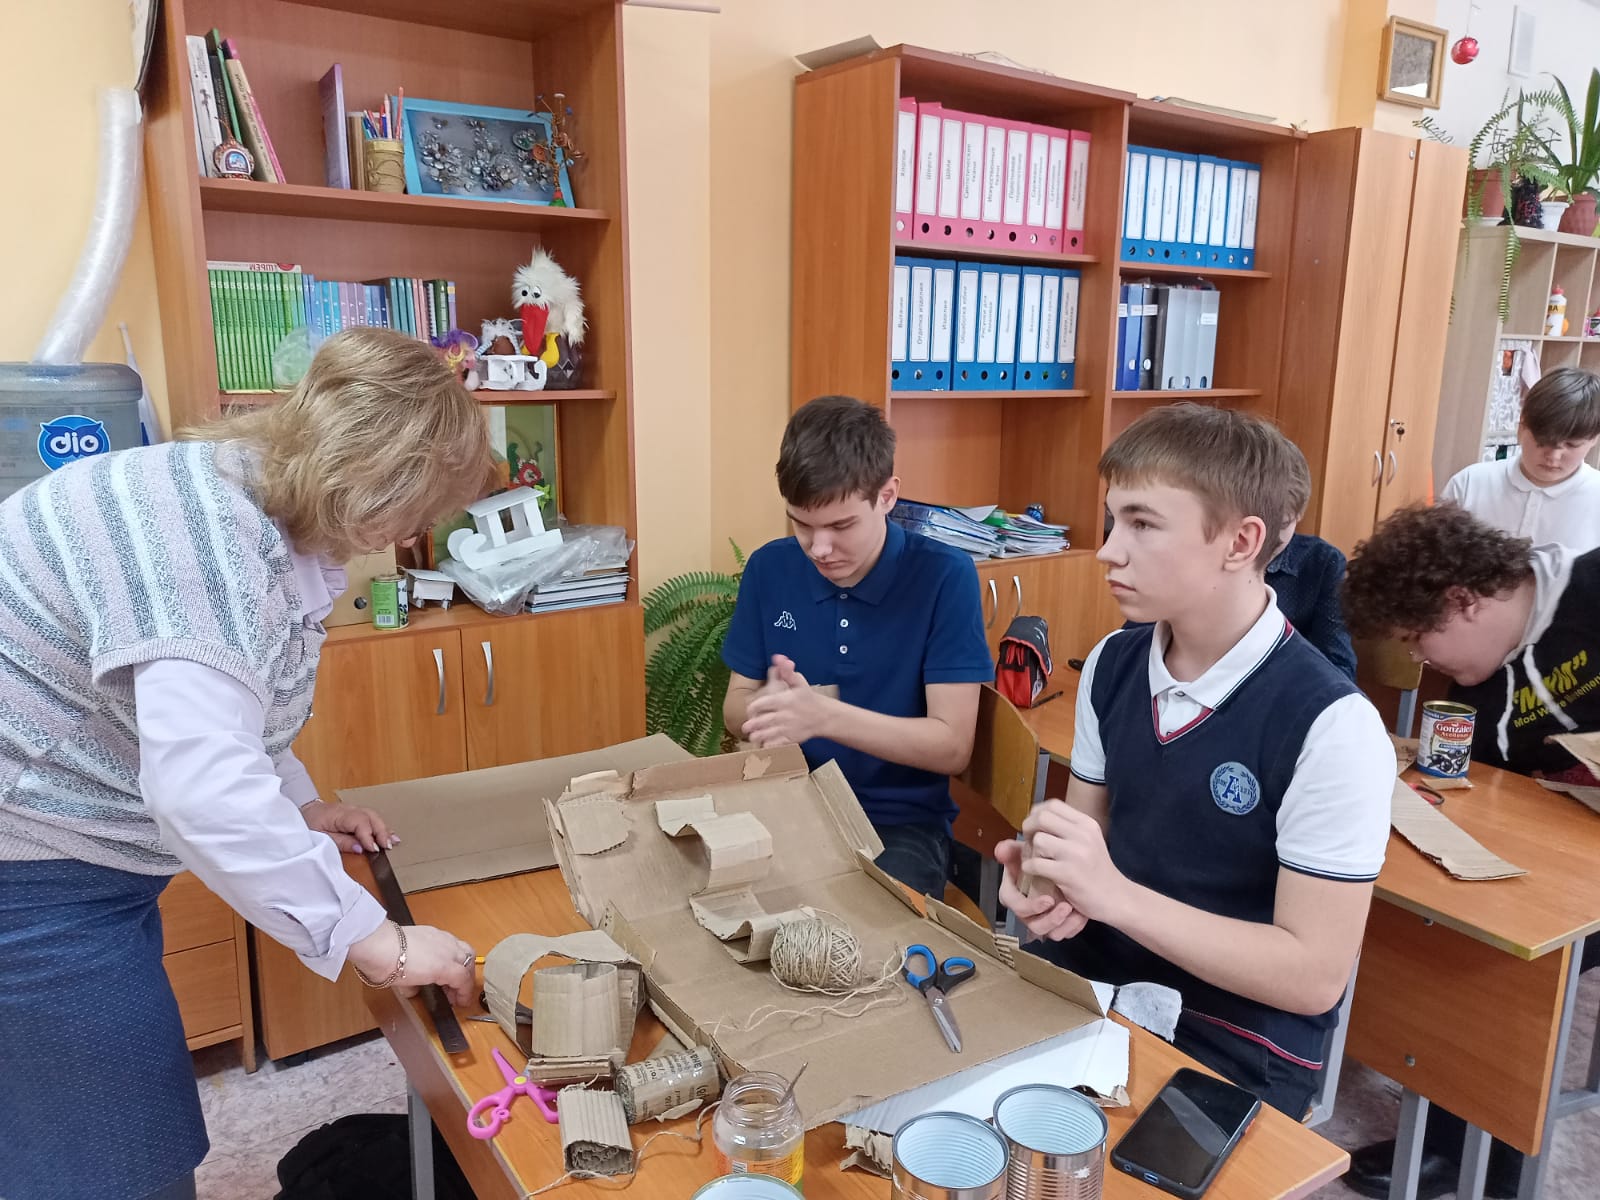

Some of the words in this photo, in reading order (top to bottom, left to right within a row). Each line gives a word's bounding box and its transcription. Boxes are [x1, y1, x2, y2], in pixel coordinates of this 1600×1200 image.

[50, 431, 99, 454] dio
[1513, 711, 1537, 728] Mod
[1537, 699, 1567, 717] We
